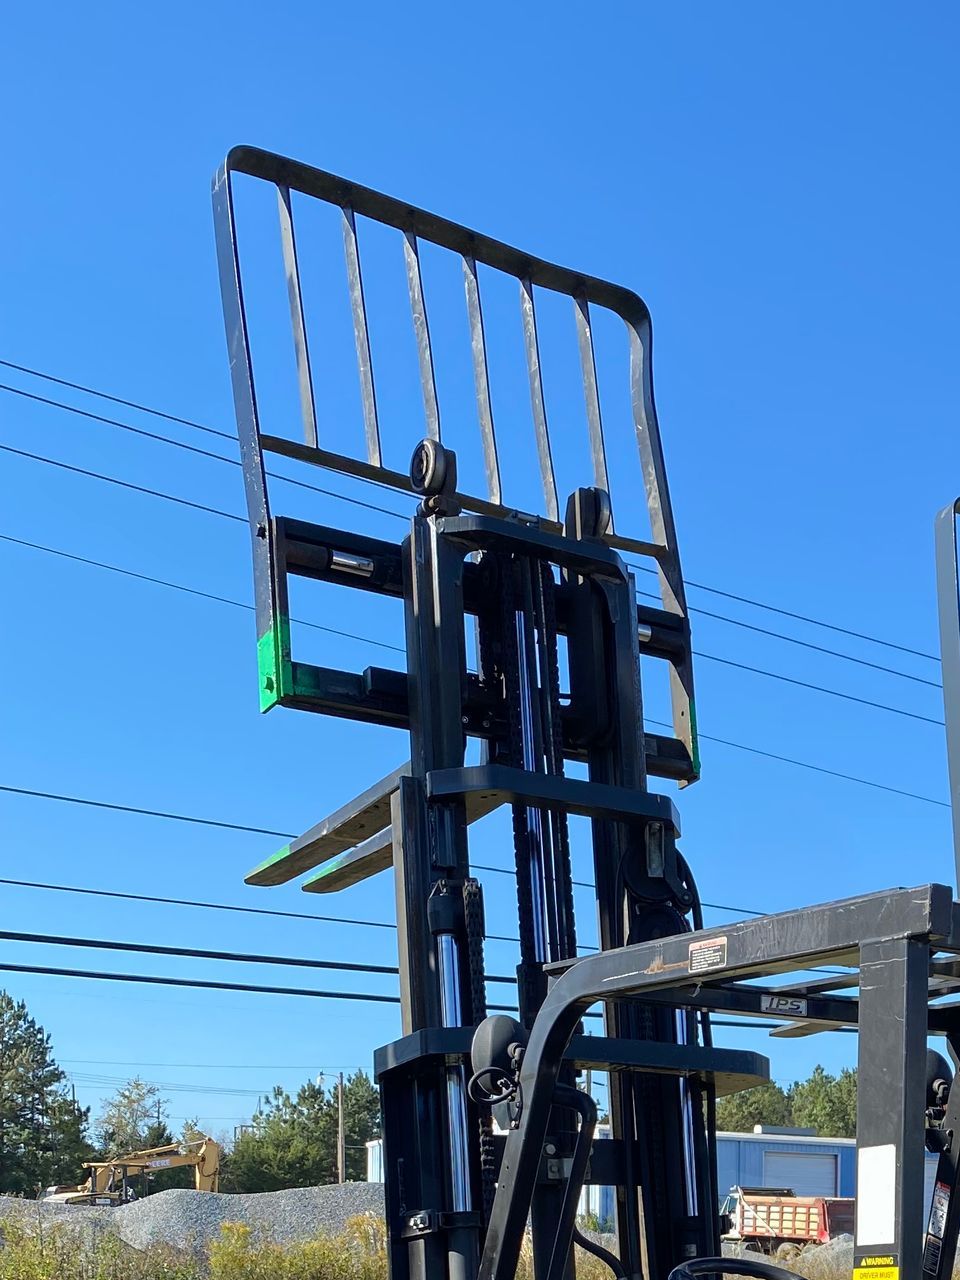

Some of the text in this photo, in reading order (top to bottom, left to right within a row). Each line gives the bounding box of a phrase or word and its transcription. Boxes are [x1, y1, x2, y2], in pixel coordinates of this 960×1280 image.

[866, 1256, 894, 1266] WARNING
[860, 1271, 895, 1280] DRIVER MUST
